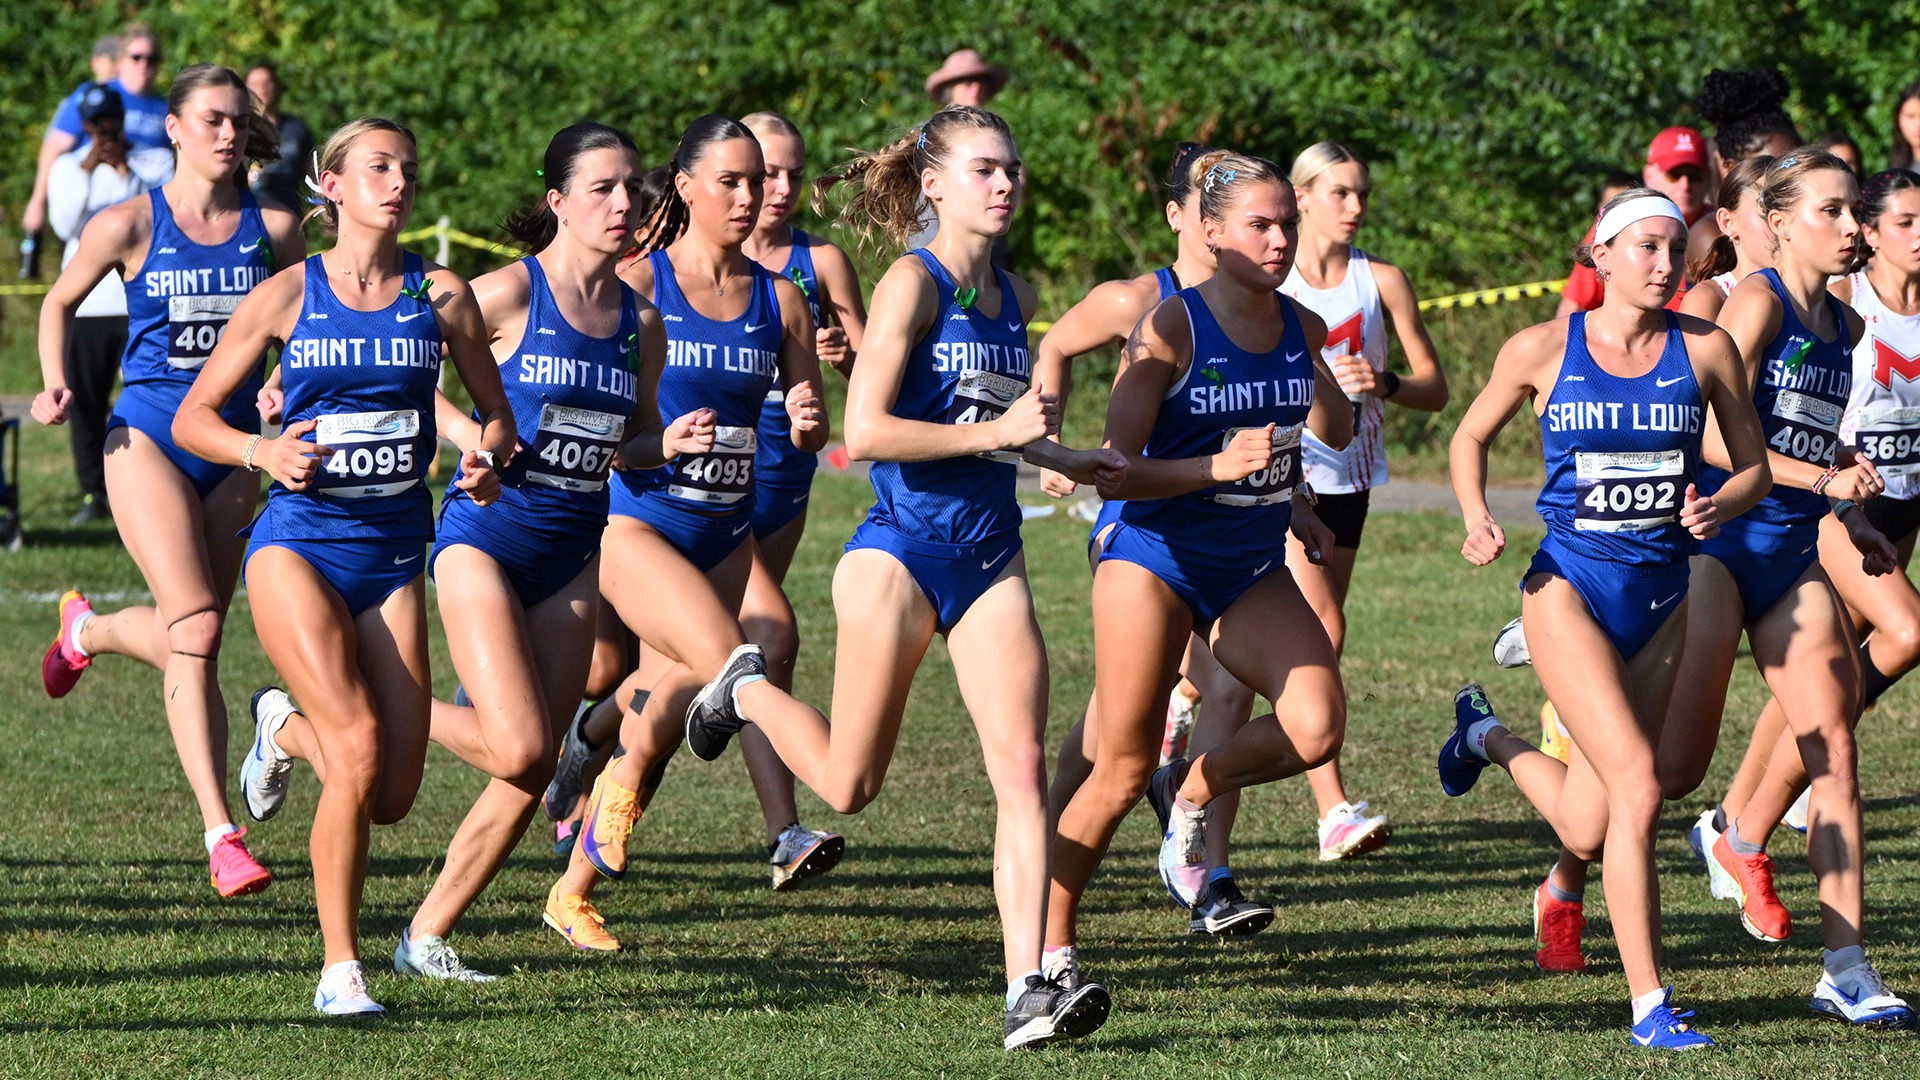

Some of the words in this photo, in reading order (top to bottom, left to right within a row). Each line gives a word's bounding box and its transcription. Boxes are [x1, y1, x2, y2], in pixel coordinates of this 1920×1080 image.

[145, 268, 213, 297] SAINT
[188, 299, 208, 308] BIG
[175, 324, 227, 351] 40
[290, 338, 366, 369] SAINT
[374, 338, 439, 370] LOUIS
[724, 346, 777, 377] LOUIS
[932, 342, 999, 372] SAINT
[519, 354, 591, 388] SAINT
[596, 364, 638, 404] LOUI
[994, 376, 1018, 392] RIVER
[1764, 359, 1827, 394] SAINT
[1190, 381, 1267, 414] SAINT
[1796, 395, 1812, 409] BIG
[1813, 399, 1837, 416] RIVER
[337, 415, 360, 427] BIG
[362, 412, 399, 425] RIVER
[559, 408, 579, 419] BIG
[581, 411, 614, 426] RIVER
[1548, 402, 1623, 432] SAINT
[1633, 403, 1700, 434] LOUIS
[721, 428, 748, 438] RVER
[1771, 426, 1837, 465] 4094
[326, 444, 413, 478] 4095
[540, 439, 614, 473] 4067
[682, 457, 751, 485] 4093
[1235, 453, 1291, 488] 069
[1623, 453, 1662, 462] RIVER
[1584, 482, 1675, 512] 4092
